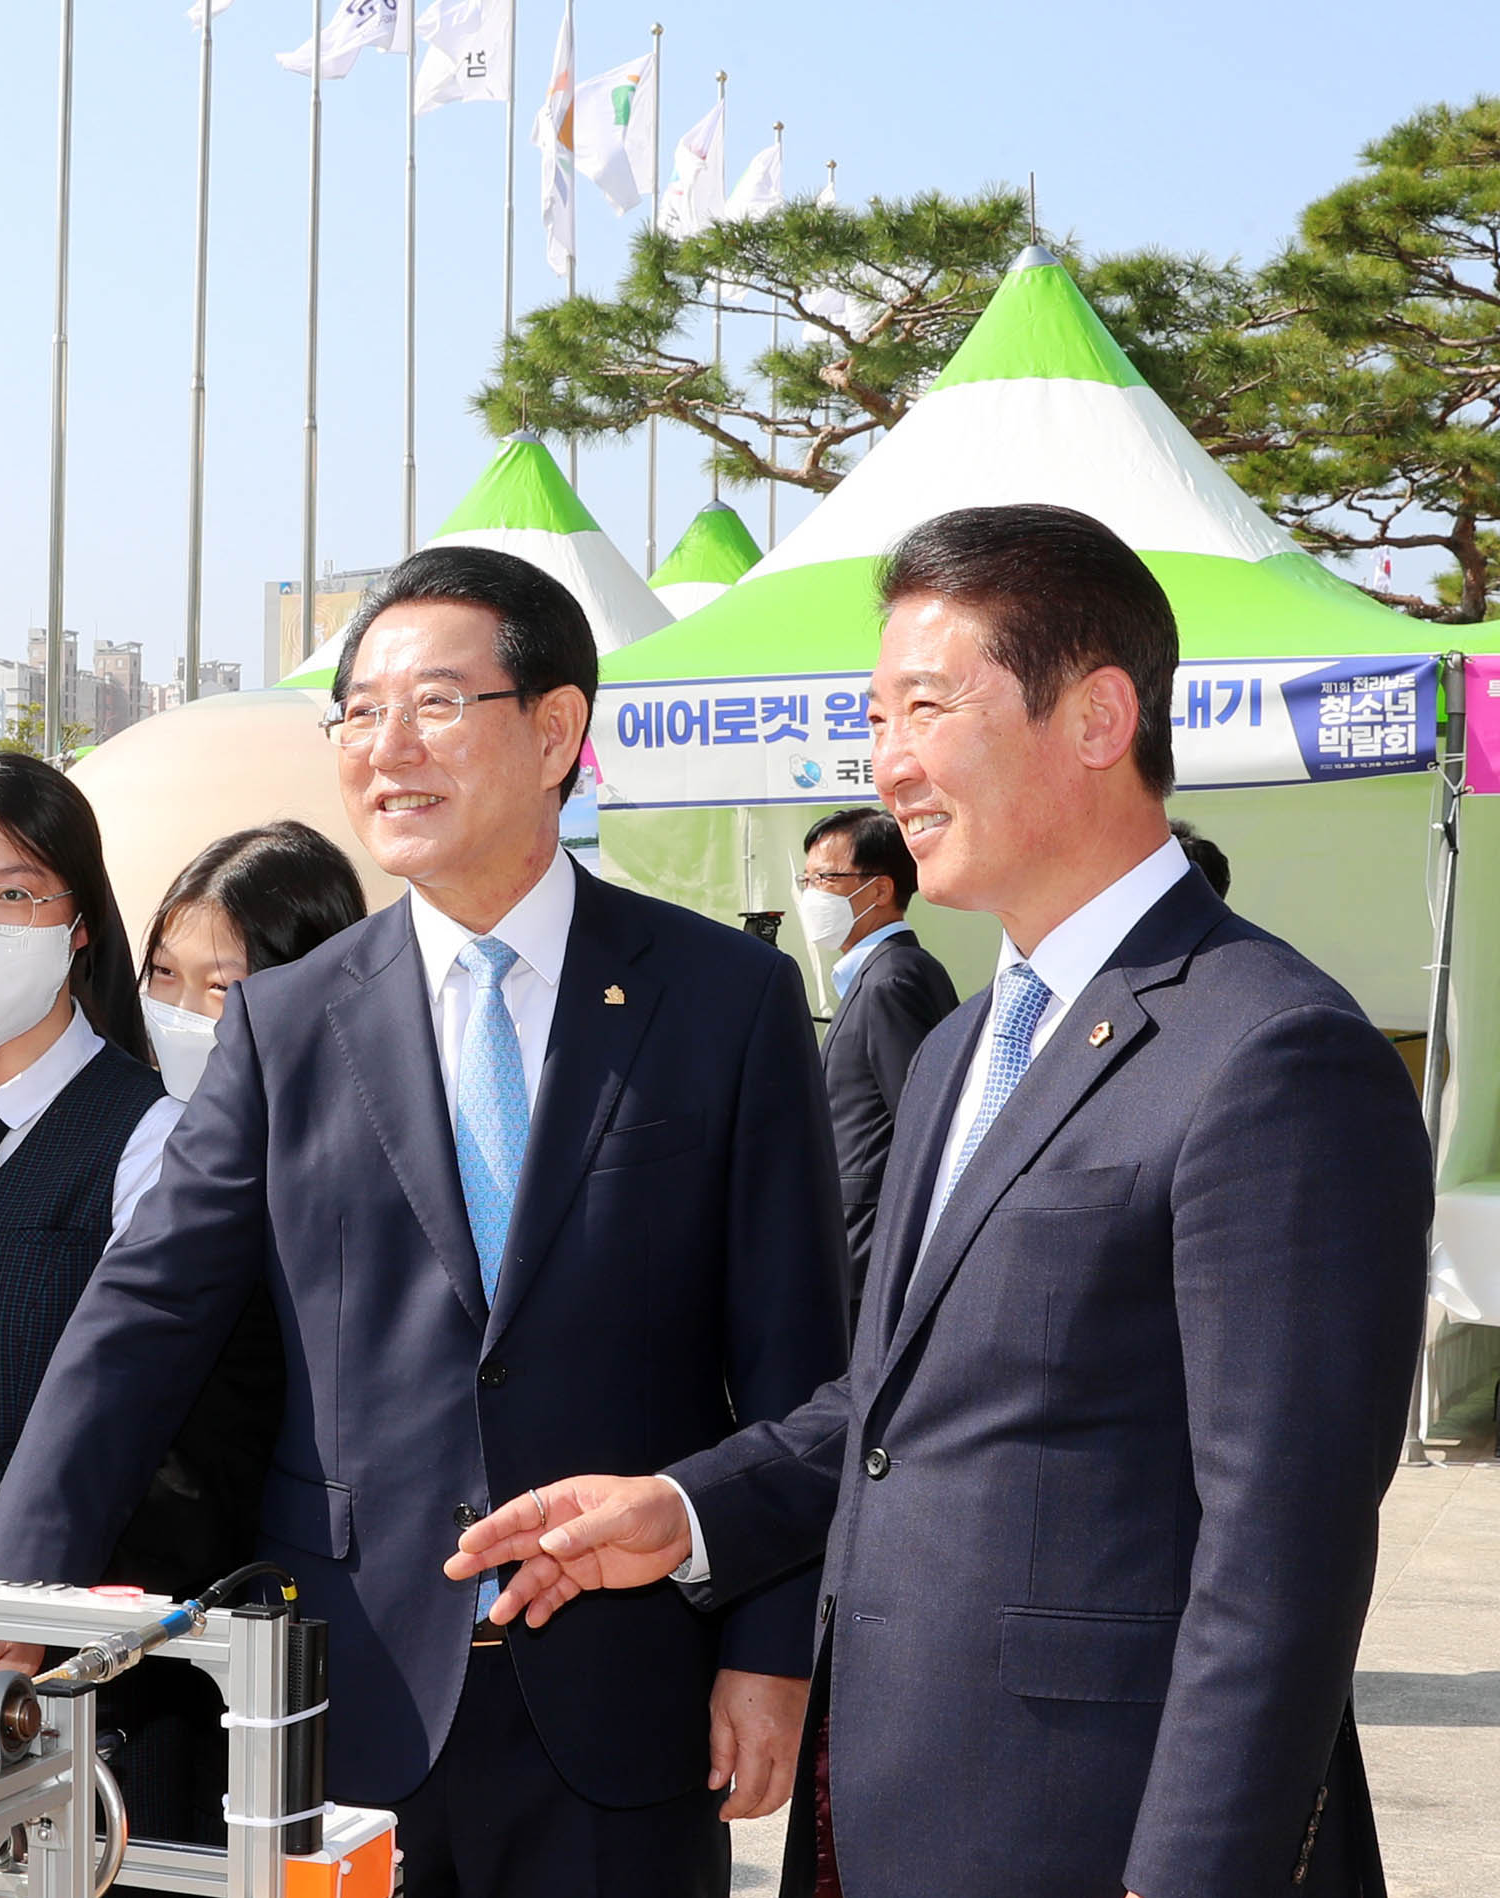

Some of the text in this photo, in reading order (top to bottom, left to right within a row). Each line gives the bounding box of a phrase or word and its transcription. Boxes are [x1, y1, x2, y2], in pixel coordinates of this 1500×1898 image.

[1320, 672, 1417, 694] 제1회 전라남도
[617, 694, 809, 749] 에어로켓
[1318, 689, 1417, 725] 청소년
[1318, 722, 1417, 759] 박람회
